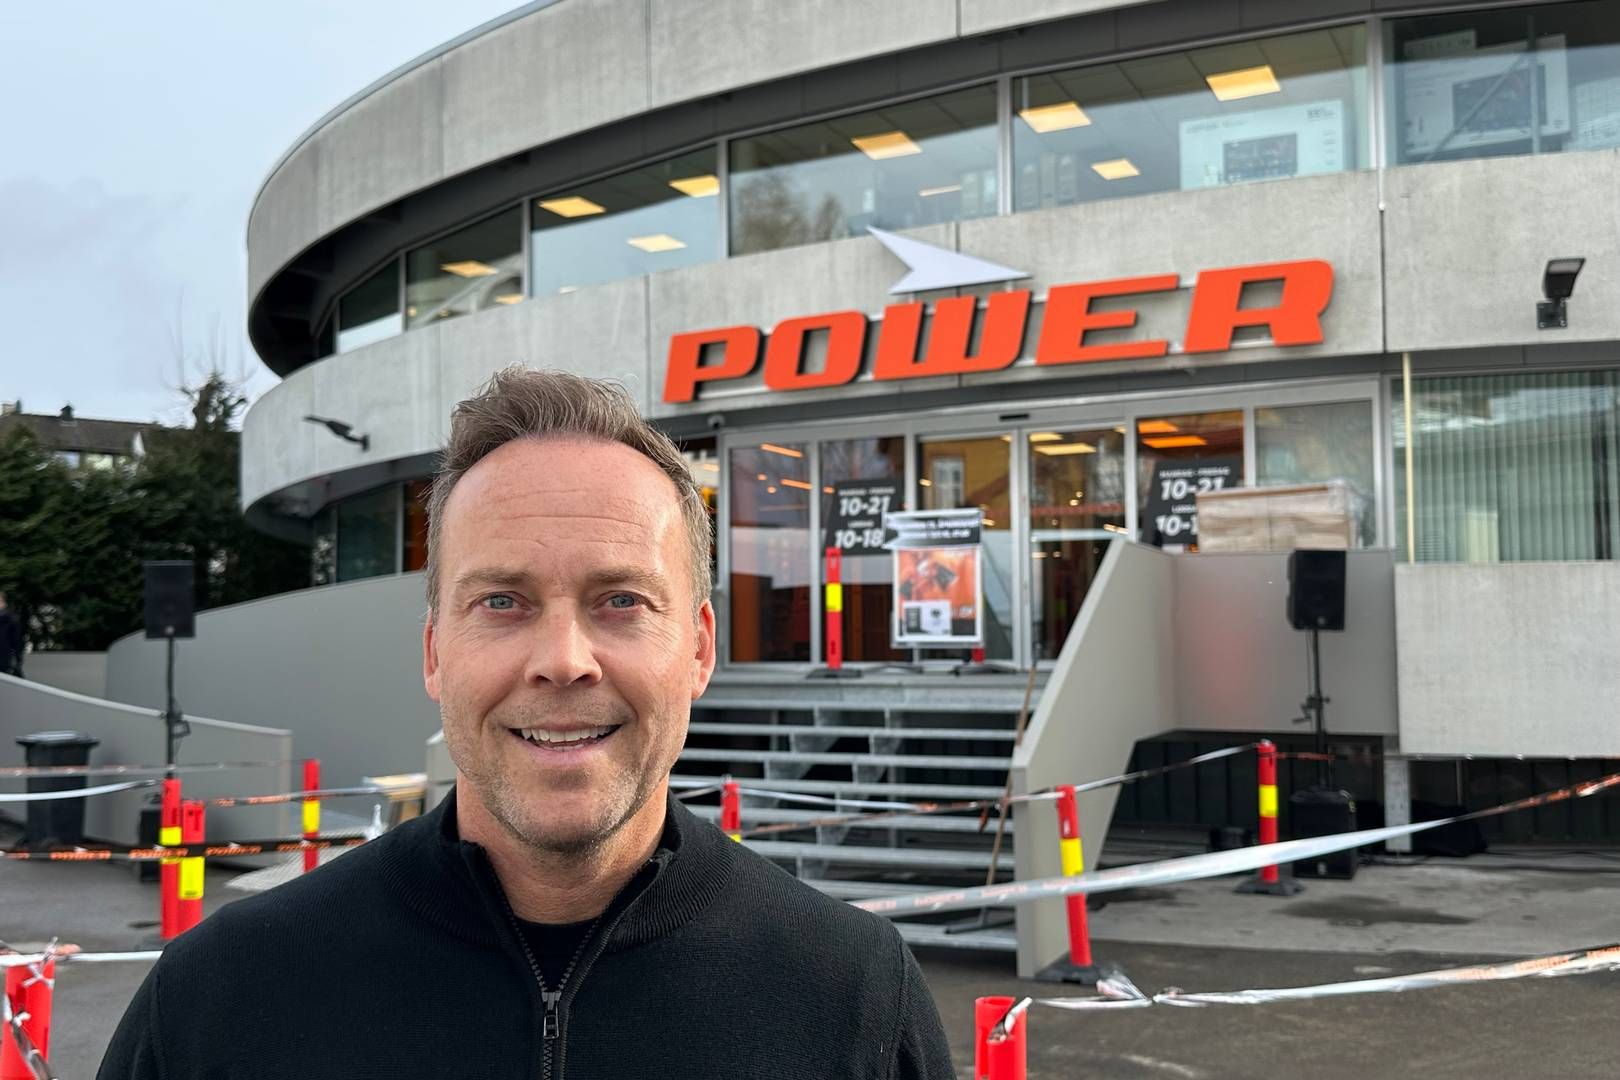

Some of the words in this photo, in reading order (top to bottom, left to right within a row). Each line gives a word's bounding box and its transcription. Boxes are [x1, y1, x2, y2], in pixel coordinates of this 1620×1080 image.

[663, 259, 1335, 403] POWER
[1161, 477, 1225, 500] 10-21
[840, 495, 891, 516] 10-21
[1155, 514, 1198, 536] 10-1
[835, 529, 884, 549] 10-18
